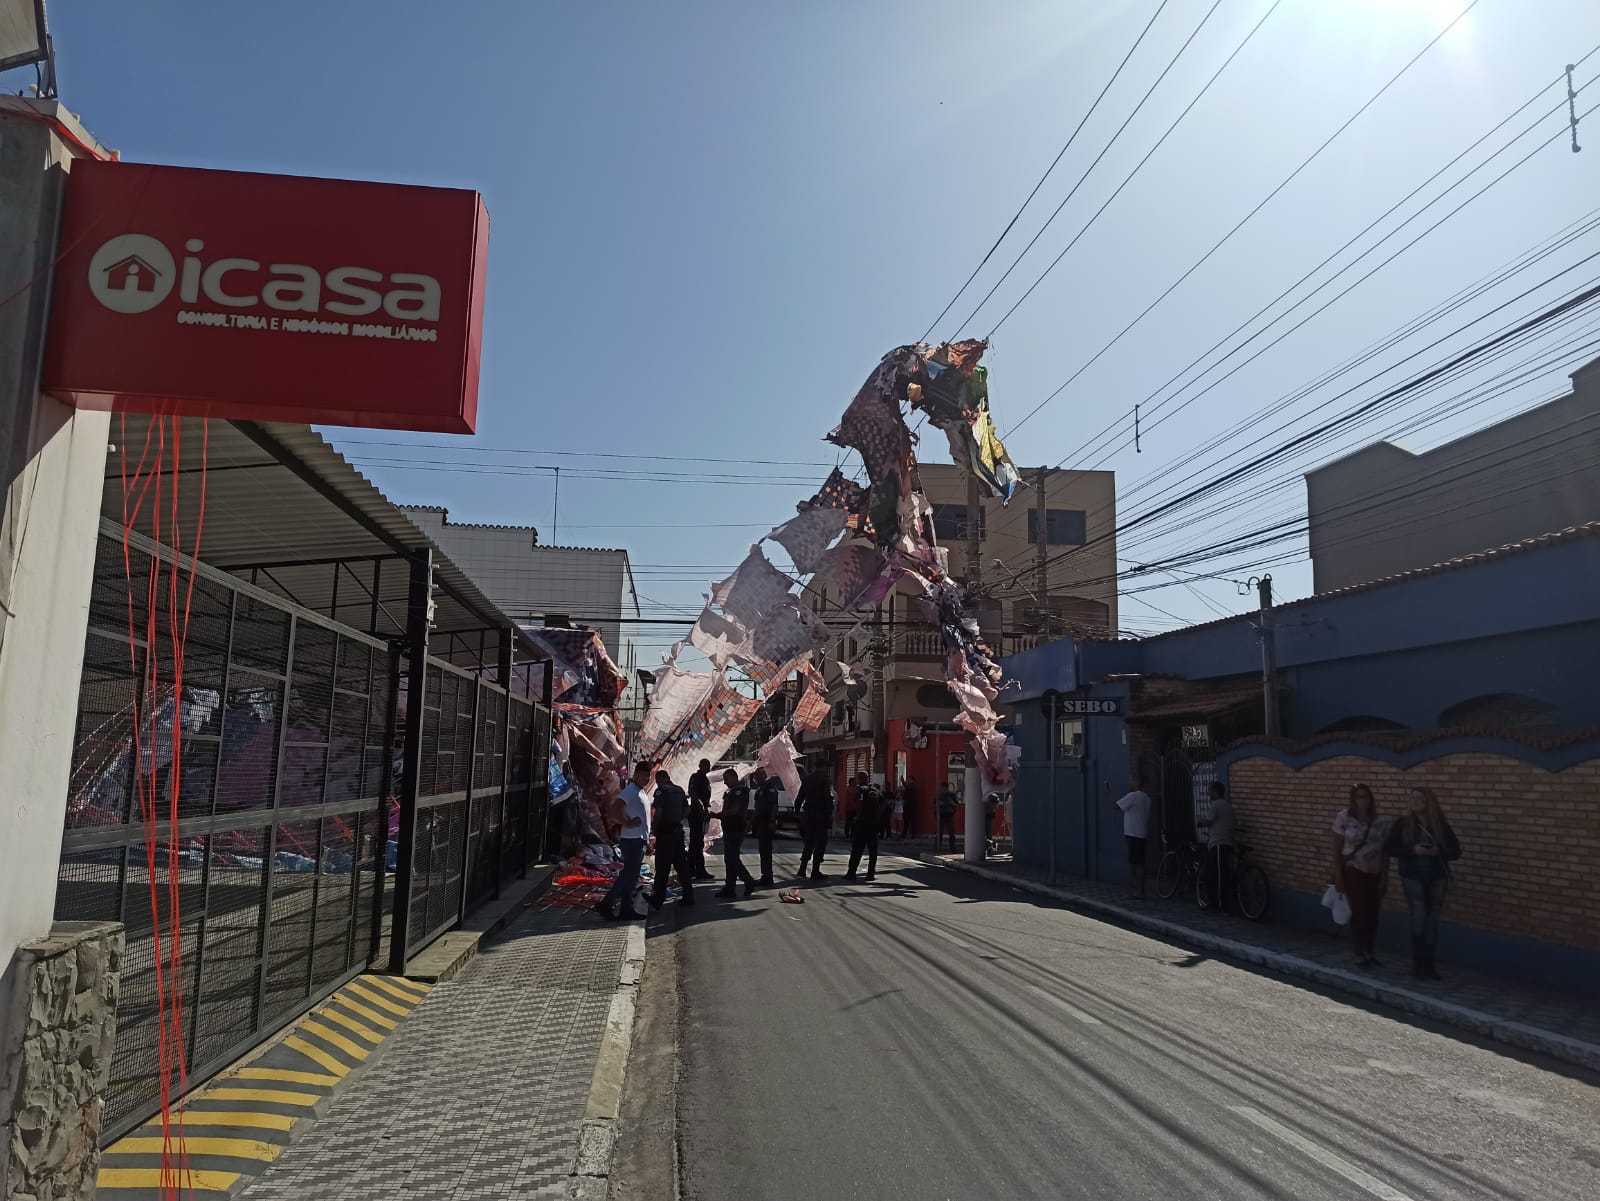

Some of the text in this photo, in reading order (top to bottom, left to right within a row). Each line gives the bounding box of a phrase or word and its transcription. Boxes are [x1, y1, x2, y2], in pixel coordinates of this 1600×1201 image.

[179, 238, 441, 323] icasa
[270, 317, 279, 331] E
[1063, 700, 1117, 713] SEBO
